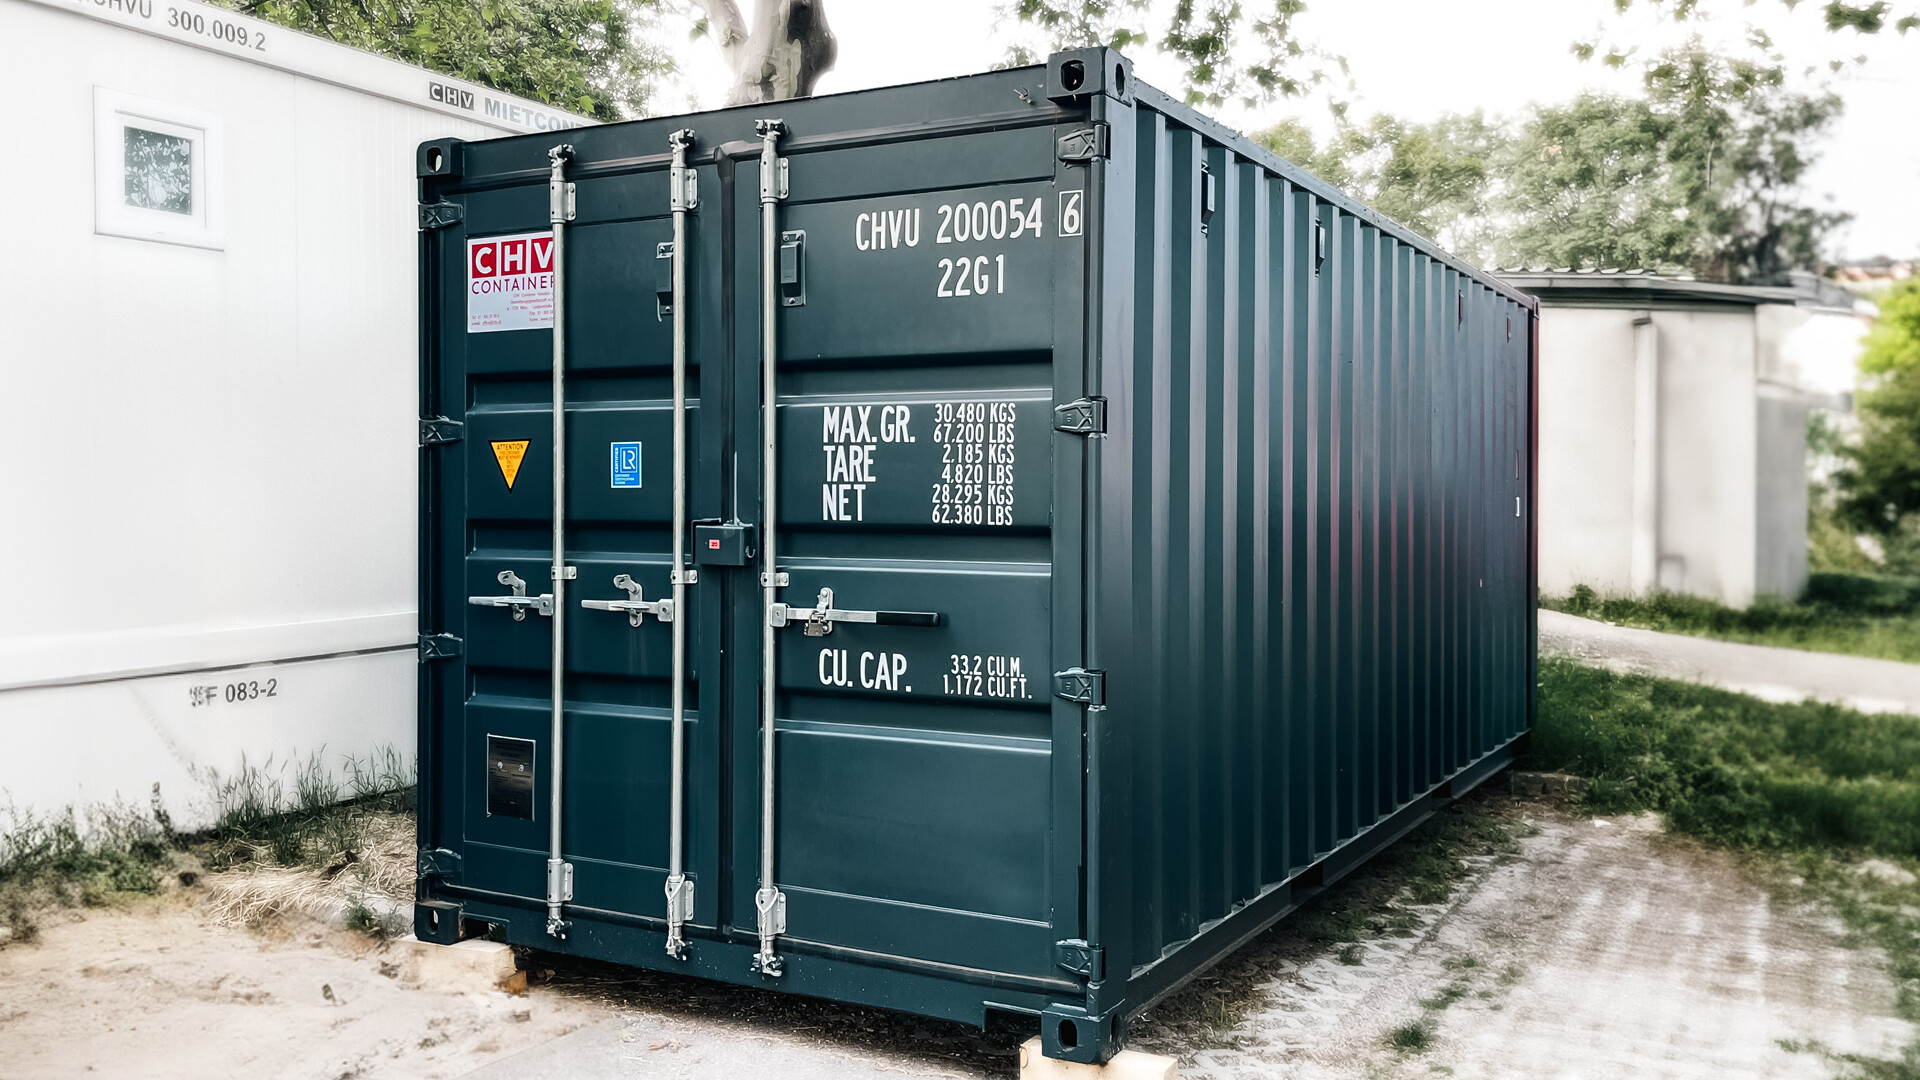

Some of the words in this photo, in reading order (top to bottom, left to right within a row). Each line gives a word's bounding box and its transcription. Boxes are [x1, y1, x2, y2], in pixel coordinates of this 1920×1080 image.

[167, 7, 266, 52] 300.009.2
[430, 82, 474, 111] CHV
[484, 97, 583, 130] MIETCO
[855, 207, 920, 251] CHVU
[936, 197, 1043, 244] 200054
[1062, 192, 1081, 235] 6
[474, 240, 553, 275] CHV
[937, 254, 1005, 298] 22G1
[934, 403, 985, 423] 30,480
[989, 402, 1016, 423] KGS
[933, 423, 984, 443] 67,200
[988, 423, 1015, 444] LBS
[497, 443, 524, 451] ATTENTION
[942, 443, 983, 464] 2,185
[988, 443, 1015, 465] KGS
[823, 445, 877, 483] TARE
[941, 463, 983, 484] 4,820
[987, 464, 1014, 485] LBS
[822, 484, 867, 522] NET
[931, 483, 983, 505] 28,295
[987, 484, 1014, 505] KGS
[931, 503, 983, 525] 62,380
[987, 504, 1013, 526] LBS
[819, 648, 853, 688] CU.
[860, 651, 912, 693] CAP.
[950, 654, 982, 676] 33.2
[987, 655, 1025, 678] CU.M.
[225, 678, 278, 703] 083-2
[943, 673, 983, 697] 1,172
[987, 676, 1032, 699] CU.FT.
